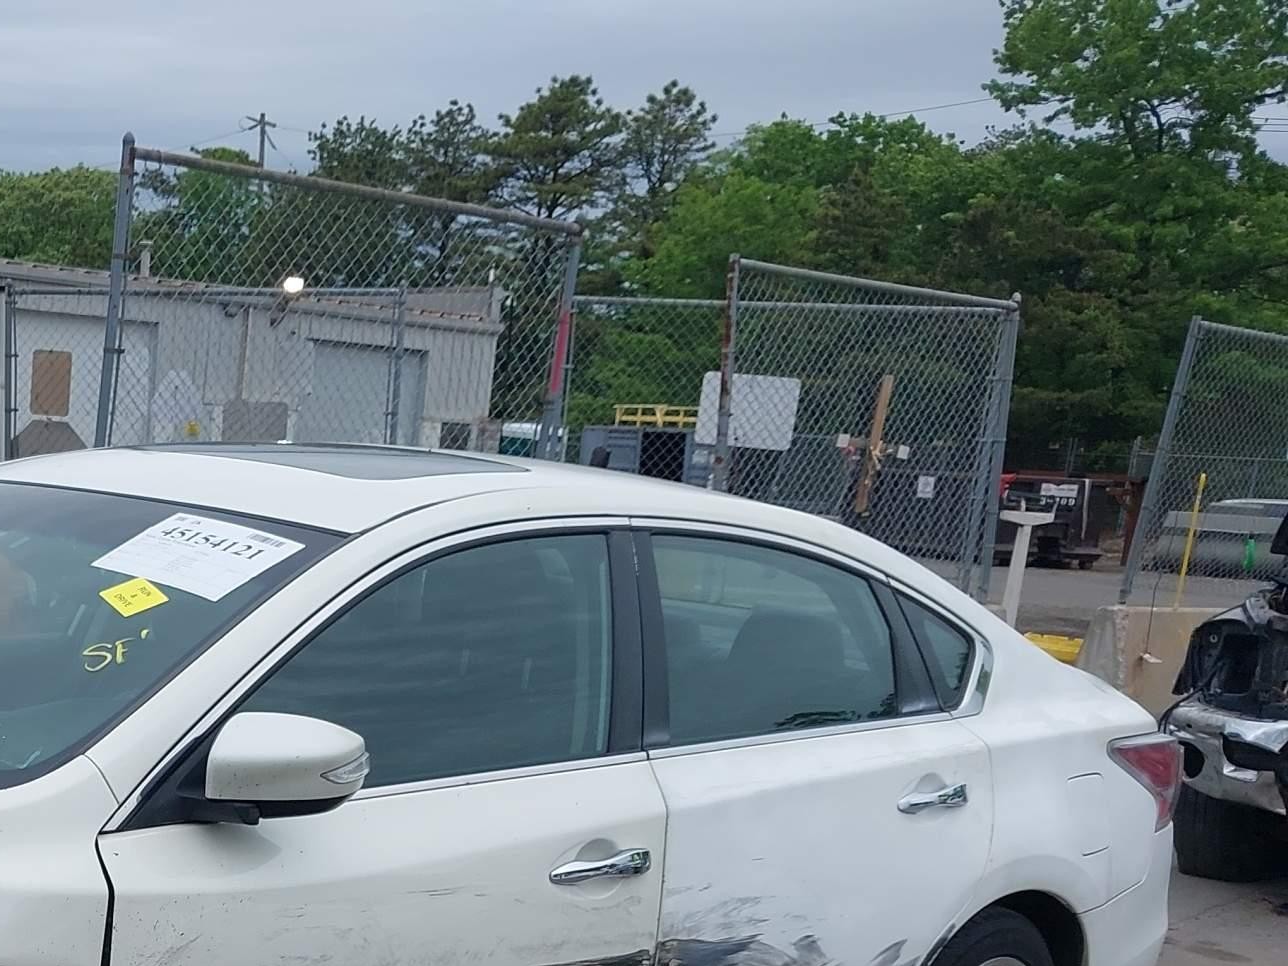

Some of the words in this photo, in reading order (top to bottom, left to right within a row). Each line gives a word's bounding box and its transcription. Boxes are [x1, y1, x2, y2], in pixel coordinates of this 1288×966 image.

[161, 526, 265, 560] 45154121
[136, 585, 153, 598] RUN
[113, 592, 133, 608] DRIVE
